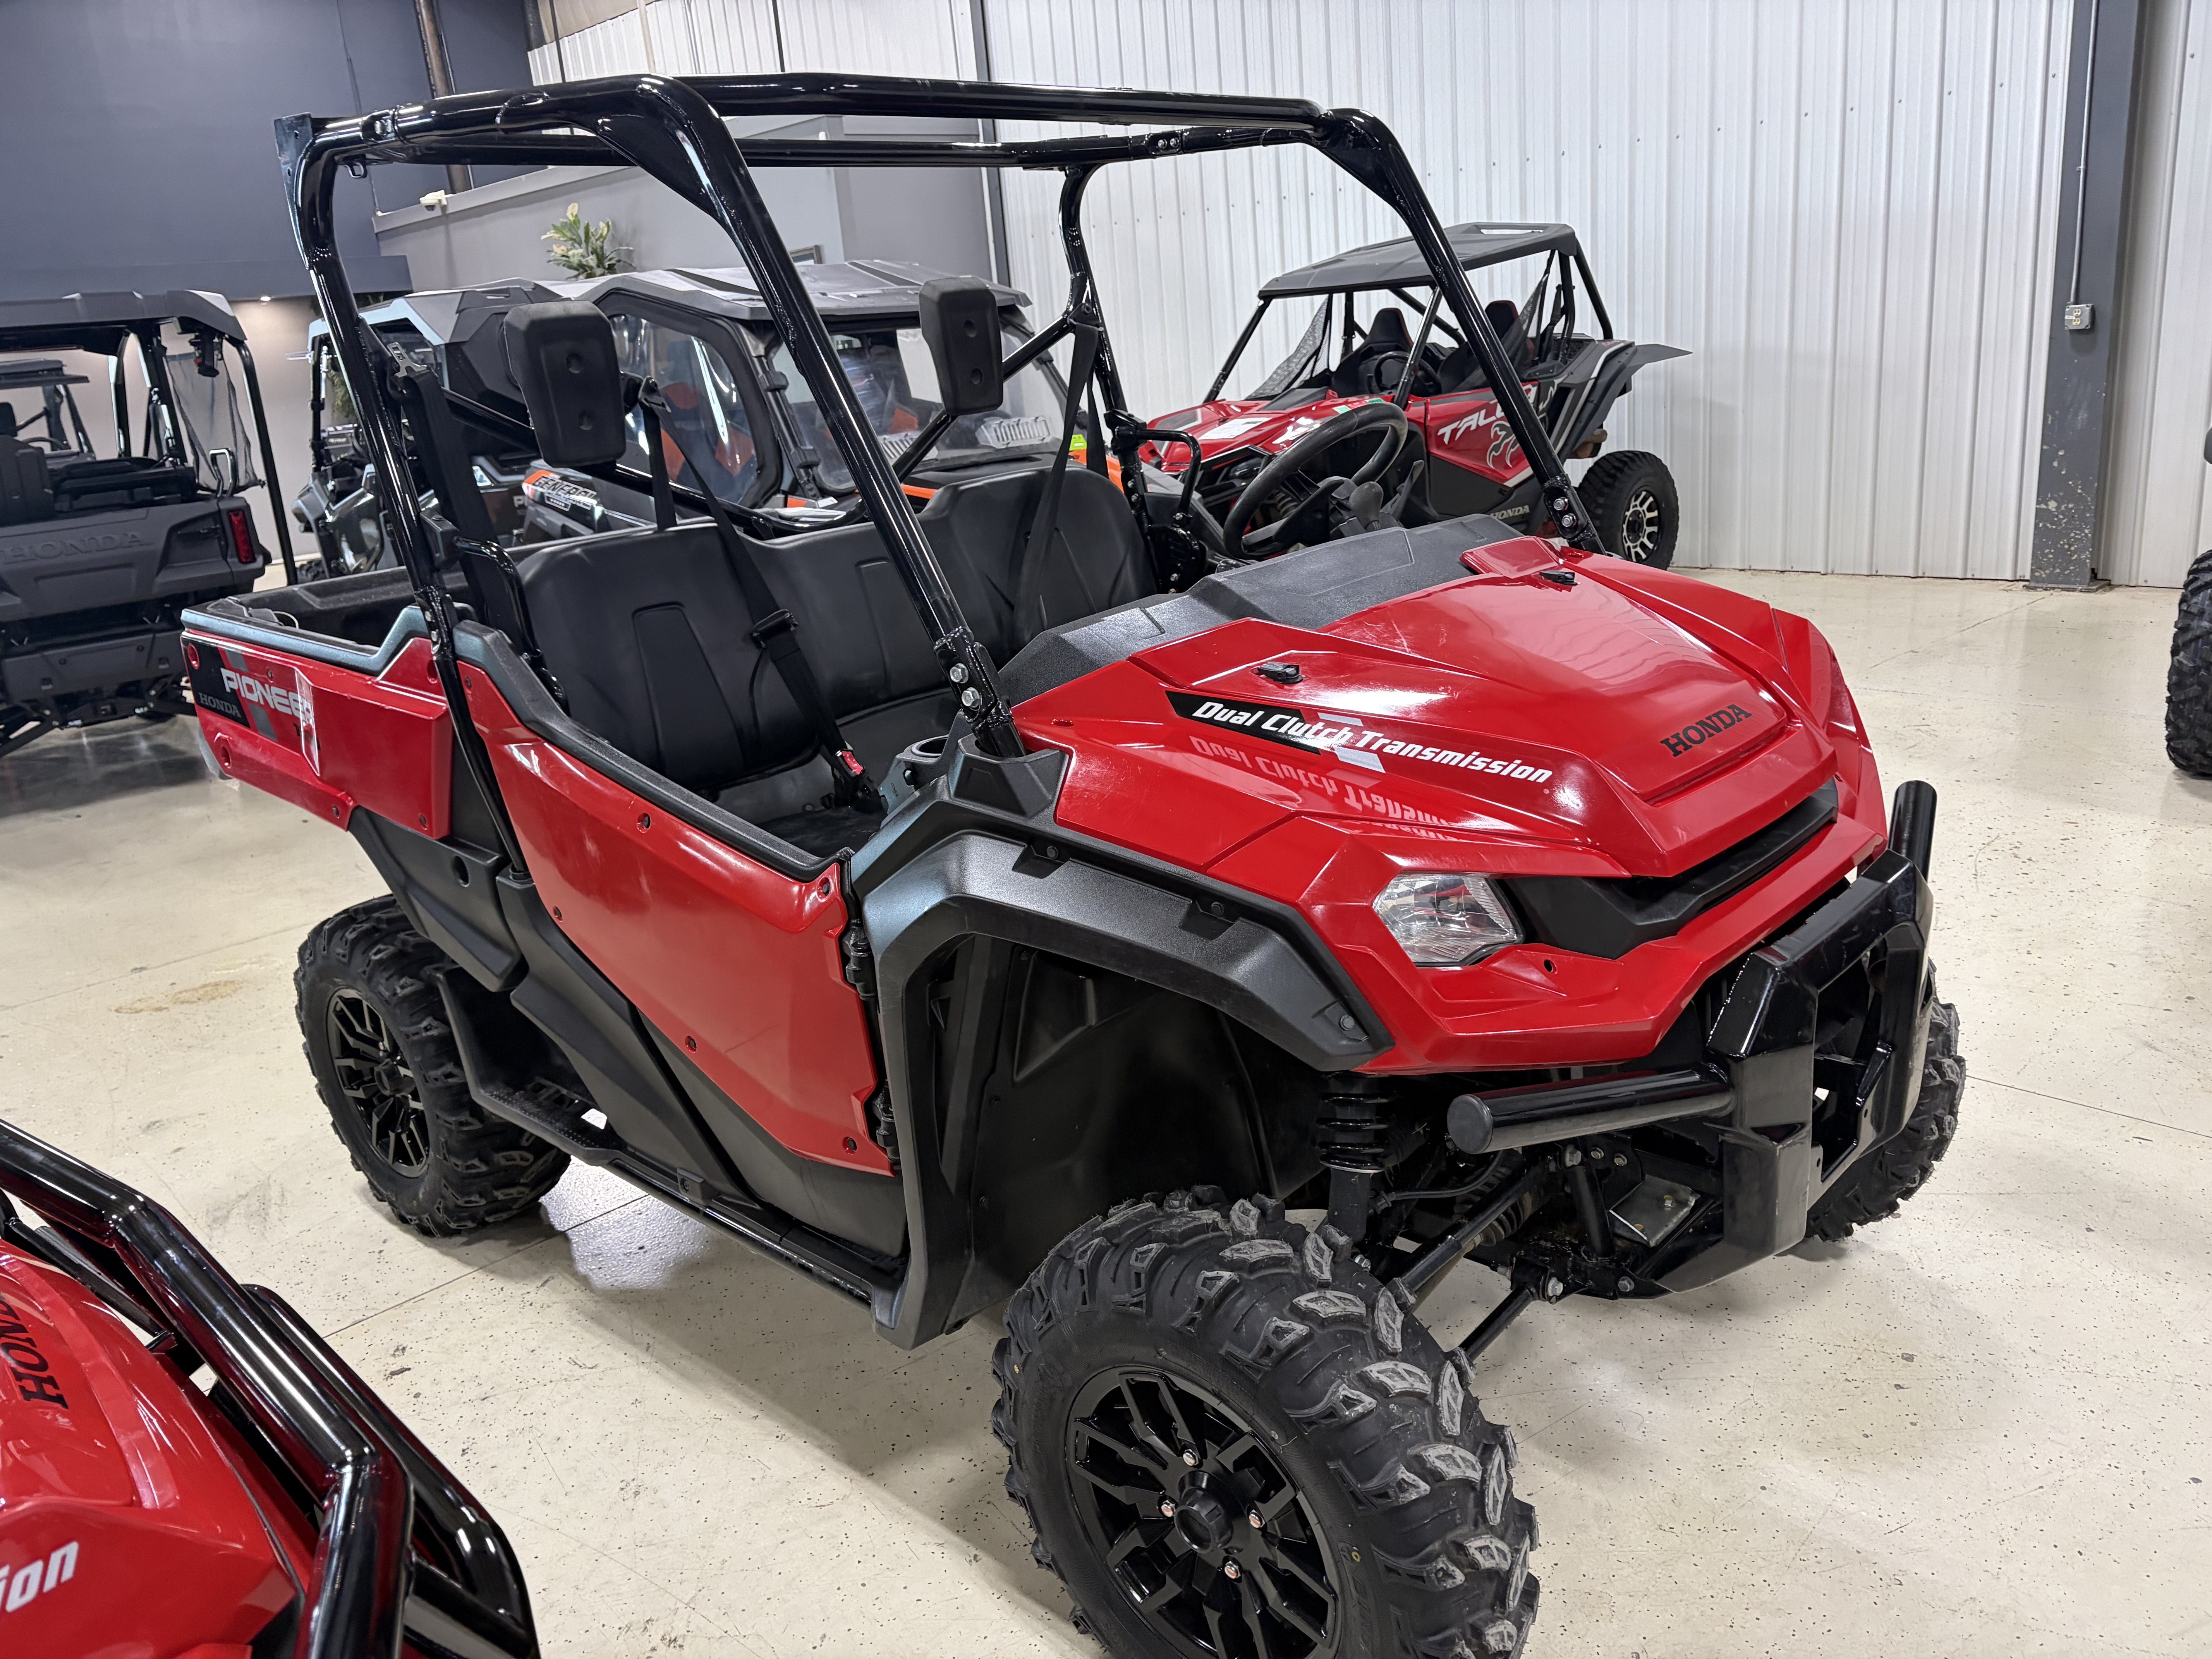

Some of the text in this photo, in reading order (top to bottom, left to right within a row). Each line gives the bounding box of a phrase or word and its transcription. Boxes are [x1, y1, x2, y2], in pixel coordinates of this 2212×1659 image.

[1490, 505, 1530, 520] HONDA
[1, 531, 154, 565] HONDA
[198, 692, 242, 718] HONDA
[1192, 701, 1553, 783] Dual Clutch Transmission
[1660, 704, 1753, 757] HONDA
